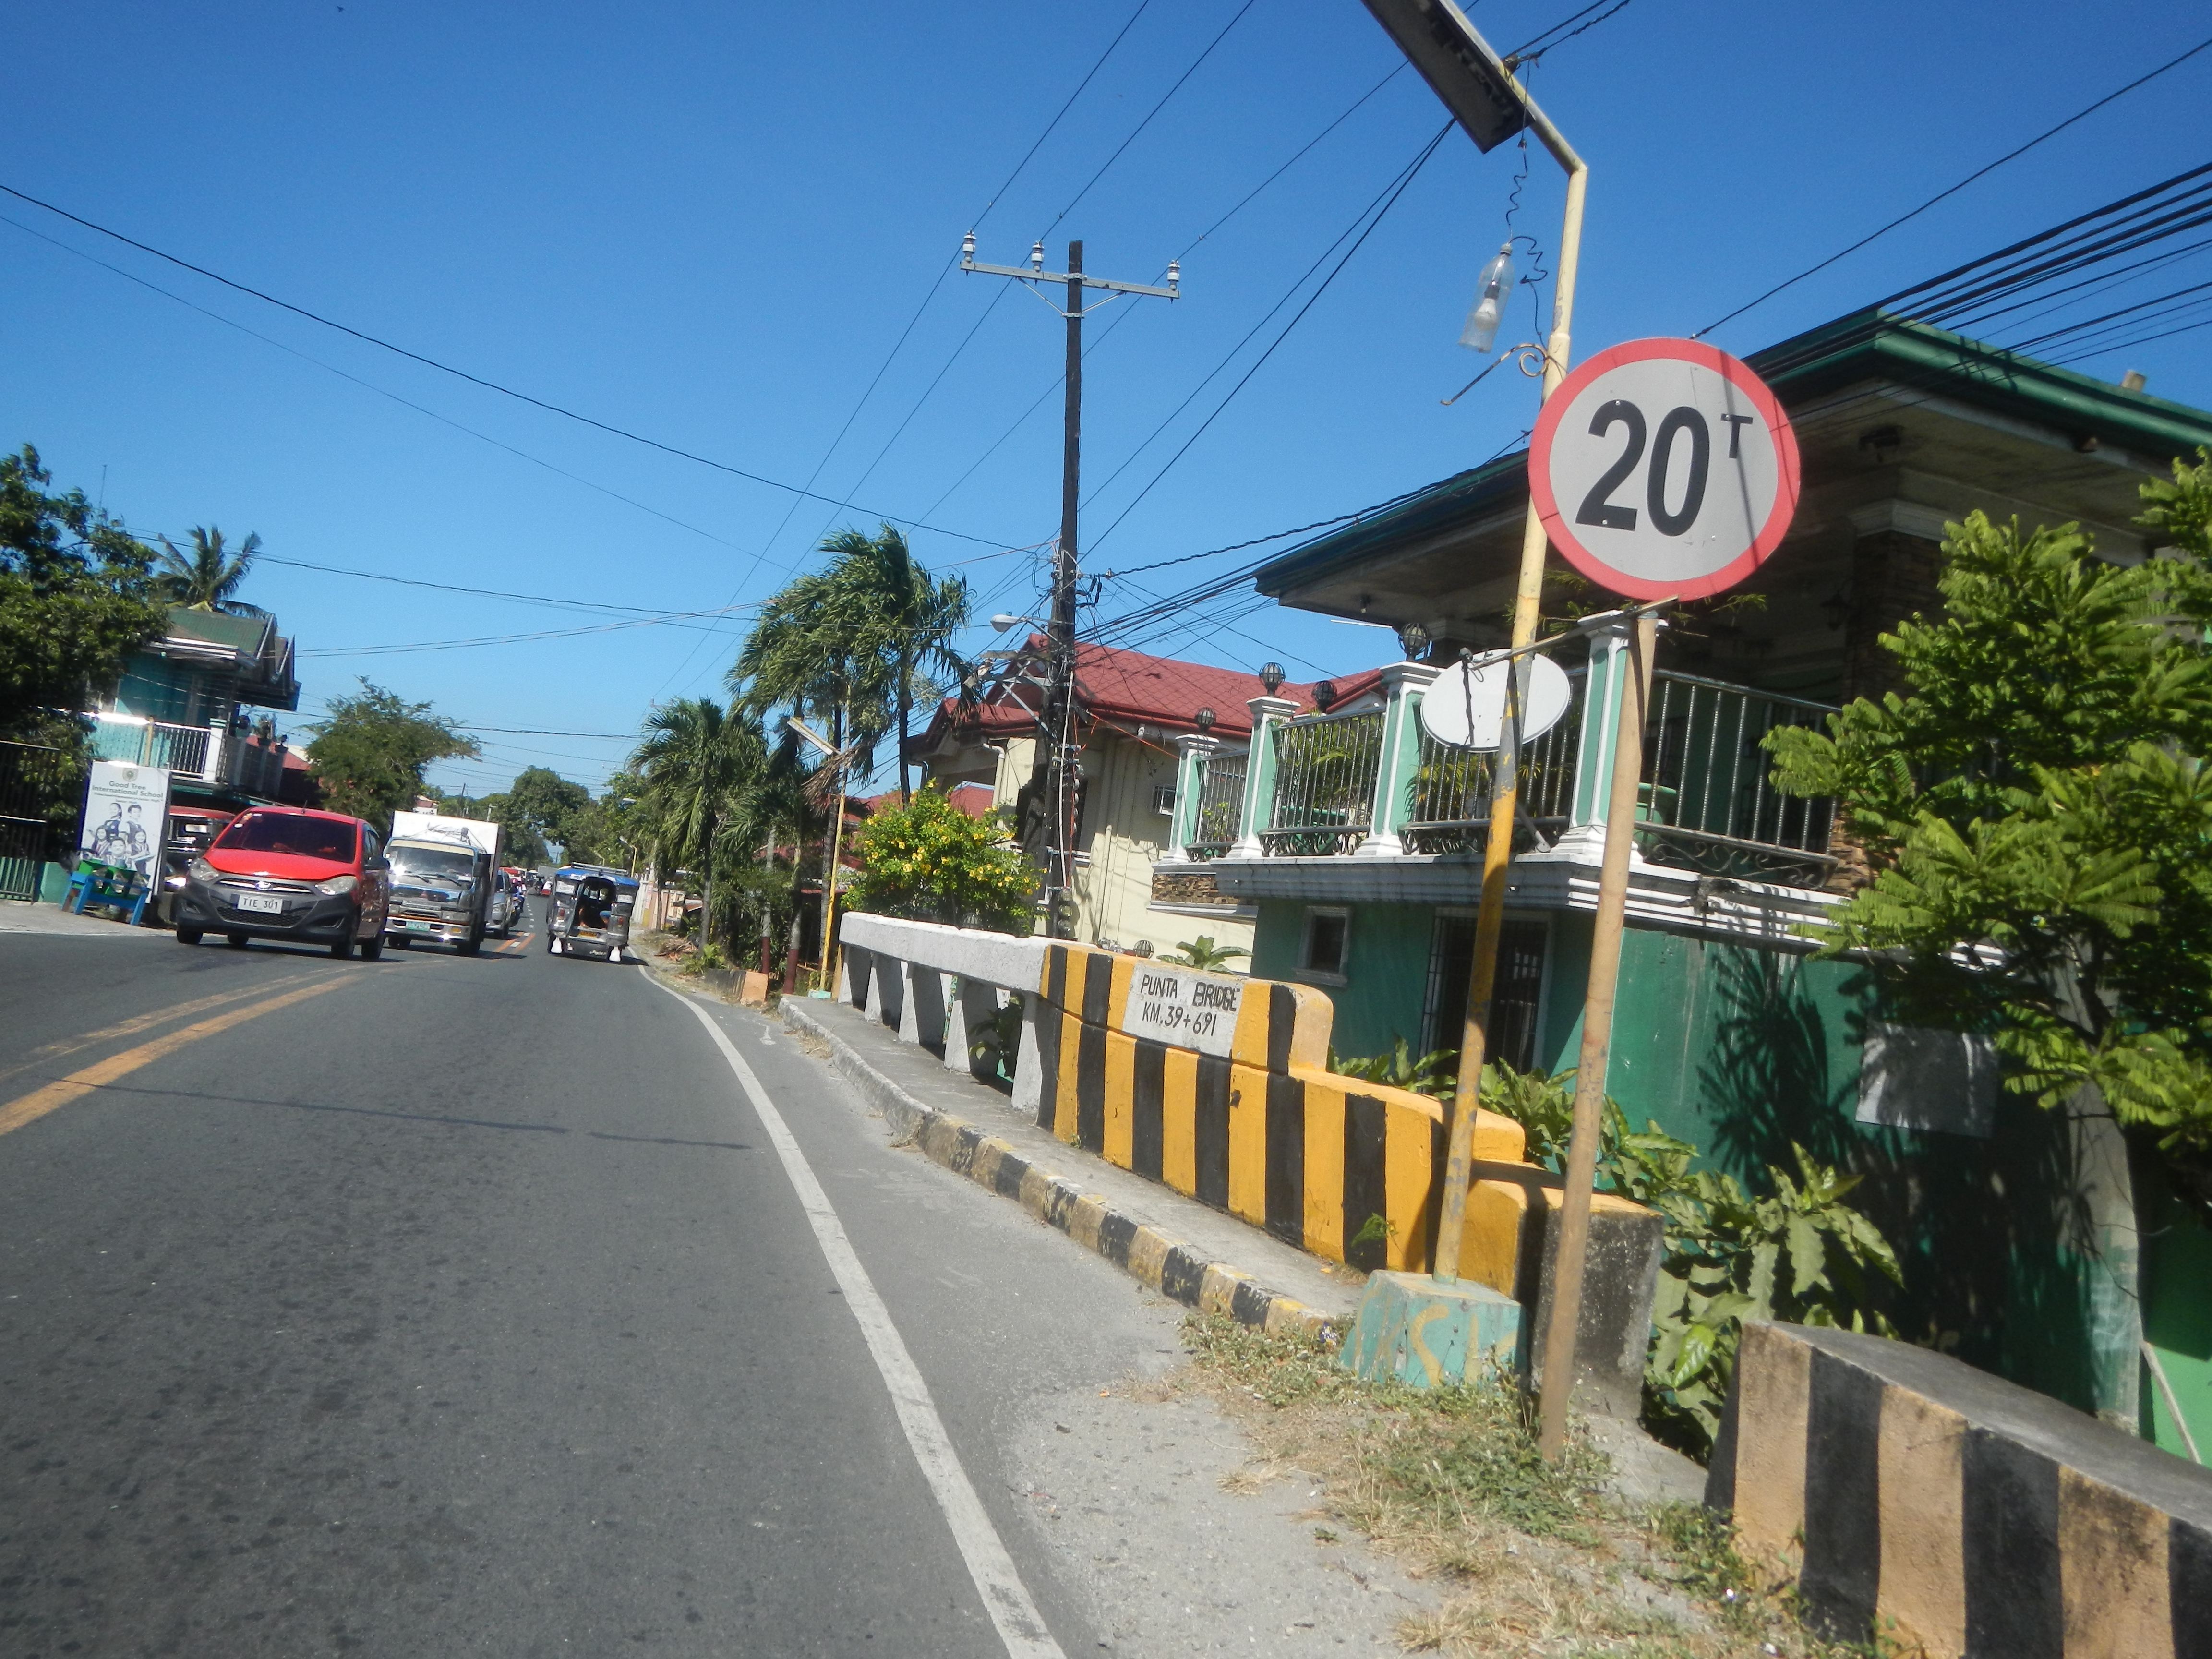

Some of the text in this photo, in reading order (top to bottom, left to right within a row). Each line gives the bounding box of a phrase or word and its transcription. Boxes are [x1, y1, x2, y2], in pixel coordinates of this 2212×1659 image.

[92, 785, 138, 795] International
[243, 898, 278, 909] TIE 301
[1140, 974, 1240, 1012] PUNTA BRIDGE
